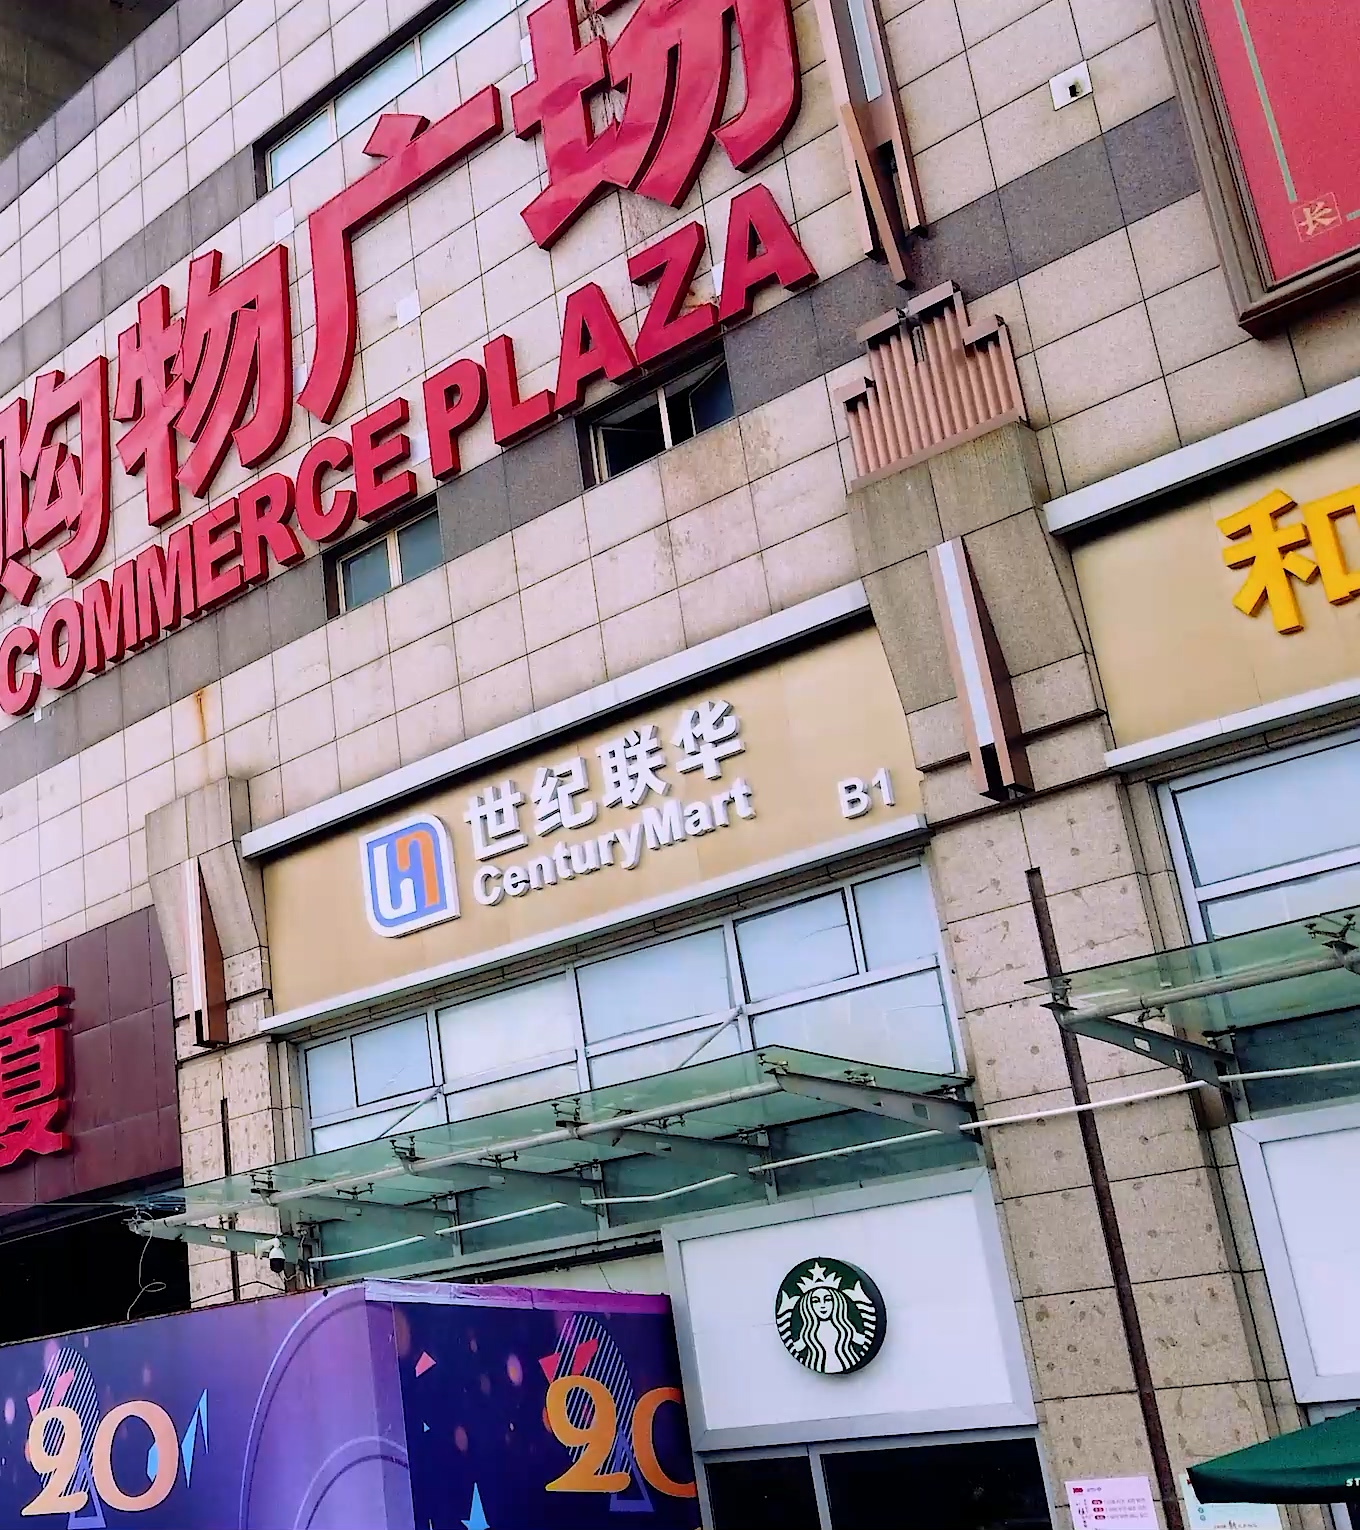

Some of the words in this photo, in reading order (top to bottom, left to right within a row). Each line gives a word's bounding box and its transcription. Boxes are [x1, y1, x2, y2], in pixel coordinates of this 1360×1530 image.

[423, 183, 819, 480] PLAZA
[1215, 483, 1360, 635] 和
[463, 699, 746, 860] 世纪联华
[472, 777, 757, 907] CenturyMart
[837, 767, 896, 820] B1
[21, 1399, 179, 1517] 20
